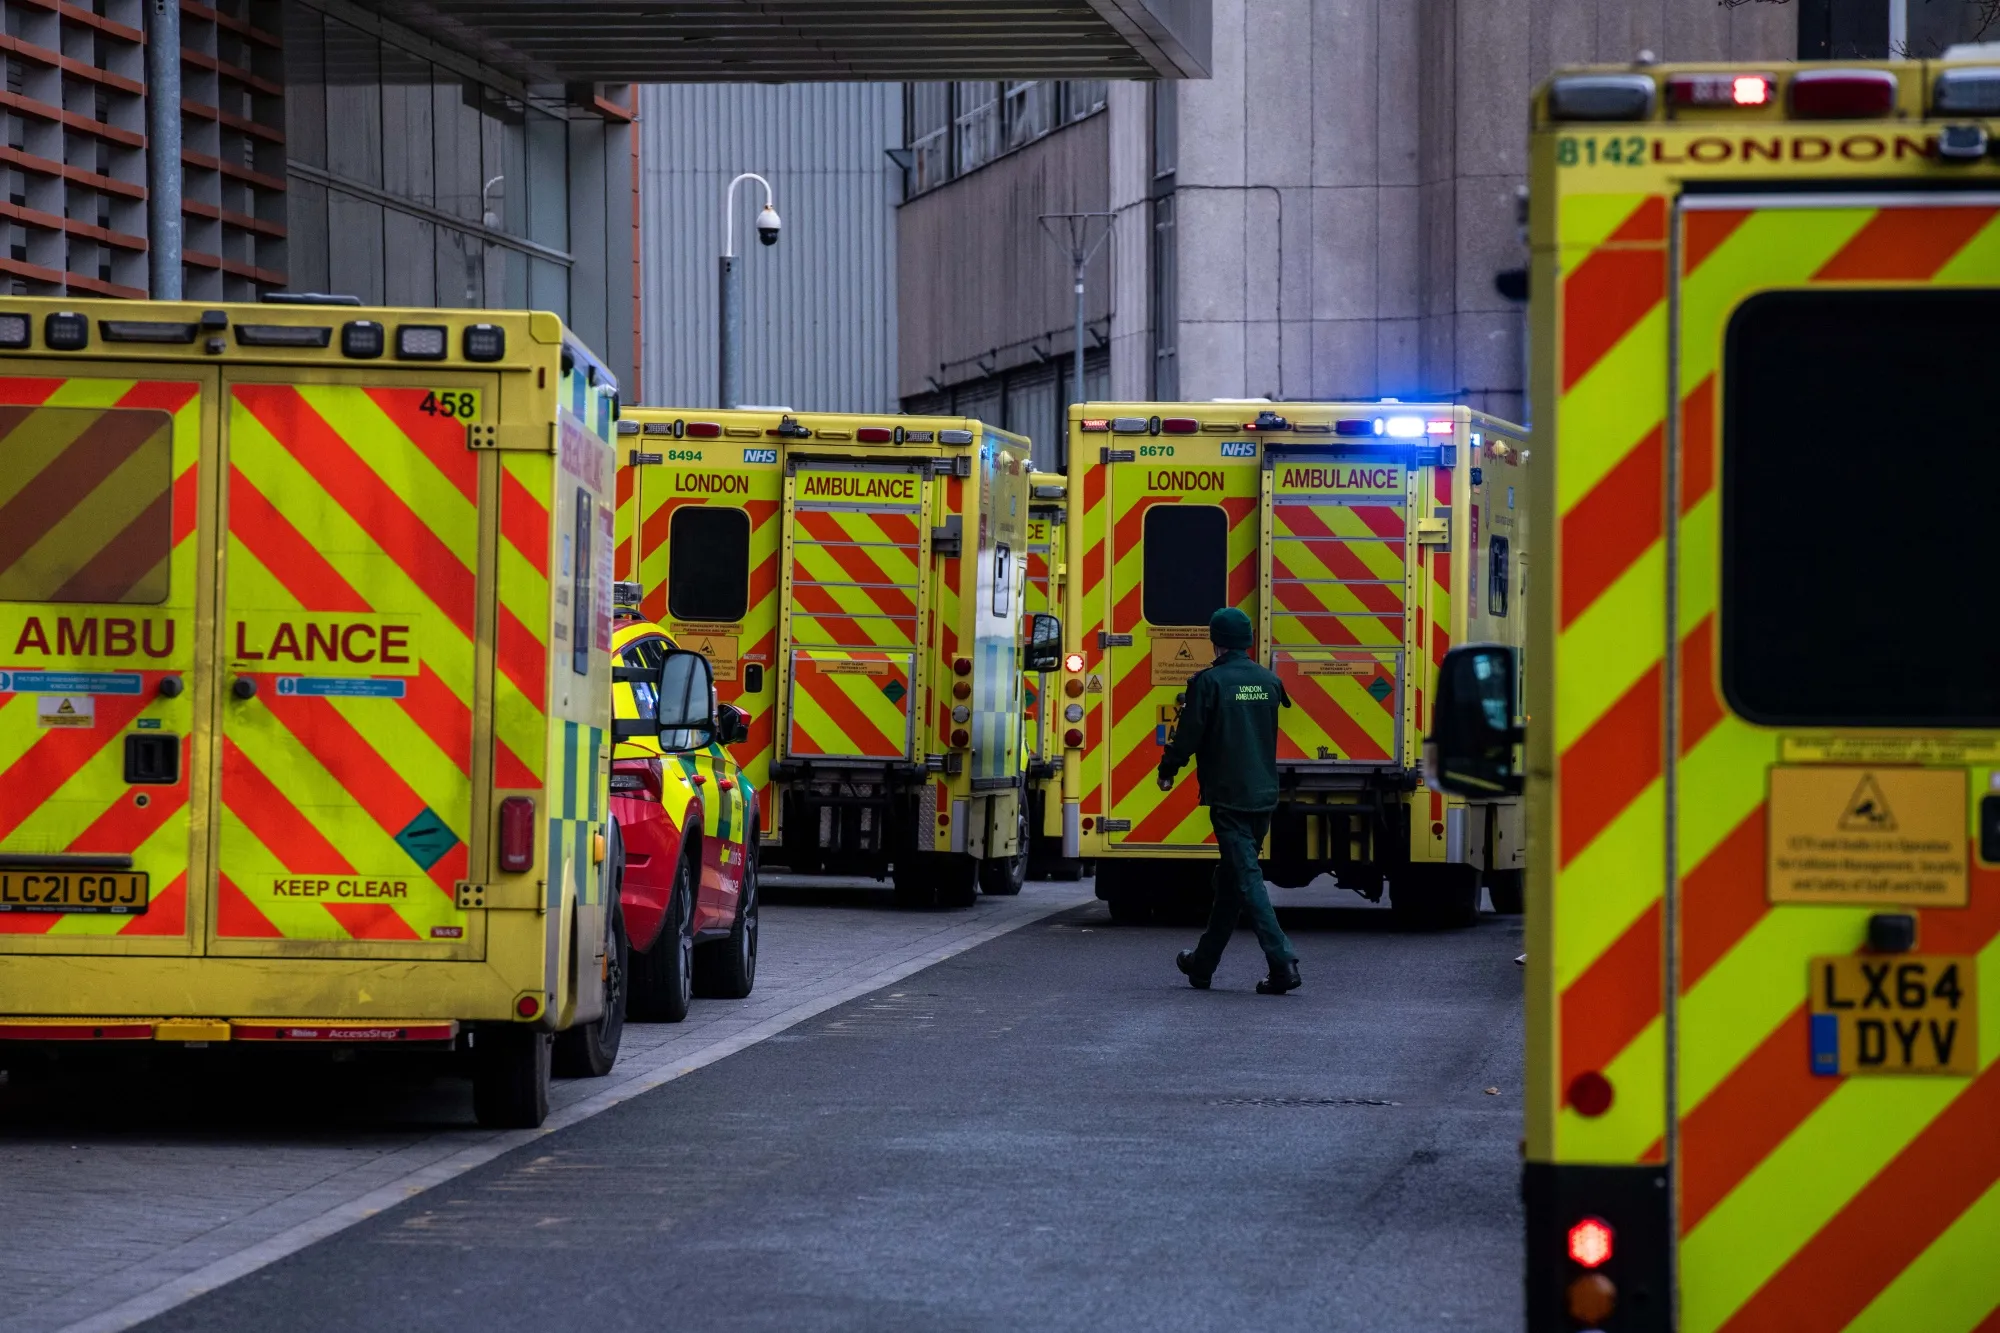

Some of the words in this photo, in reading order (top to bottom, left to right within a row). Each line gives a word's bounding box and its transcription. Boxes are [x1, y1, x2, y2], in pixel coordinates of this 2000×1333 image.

[1556, 137, 1647, 167] 8142
[1651, 135, 1941, 165] LONDON
[419, 391, 475, 418] 458
[668, 449, 703, 461] 8494
[744, 449, 776, 463] NHS
[1140, 445, 1175, 457] 8670
[1221, 443, 1255, 456] NHS
[675, 472, 749, 495] LONDON
[803, 476, 915, 499] AMBULANCE
[1147, 470, 1225, 491] LONDON
[1281, 468, 1399, 489] AMBULANCE
[13, 616, 176, 658] AMBU
[235, 621, 411, 664] LANCE
[1235, 692, 1269, 701] AMBULANCE
[1239, 685, 1263, 693] LONDON
[2, 875, 70, 903] LC21
[78, 876, 137, 904] GOJ
[273, 879, 330, 897] KEEP
[336, 880, 408, 898] CLEAR
[1824, 962, 1964, 1010] LX64
[1857, 1019, 1958, 1066] DYV
